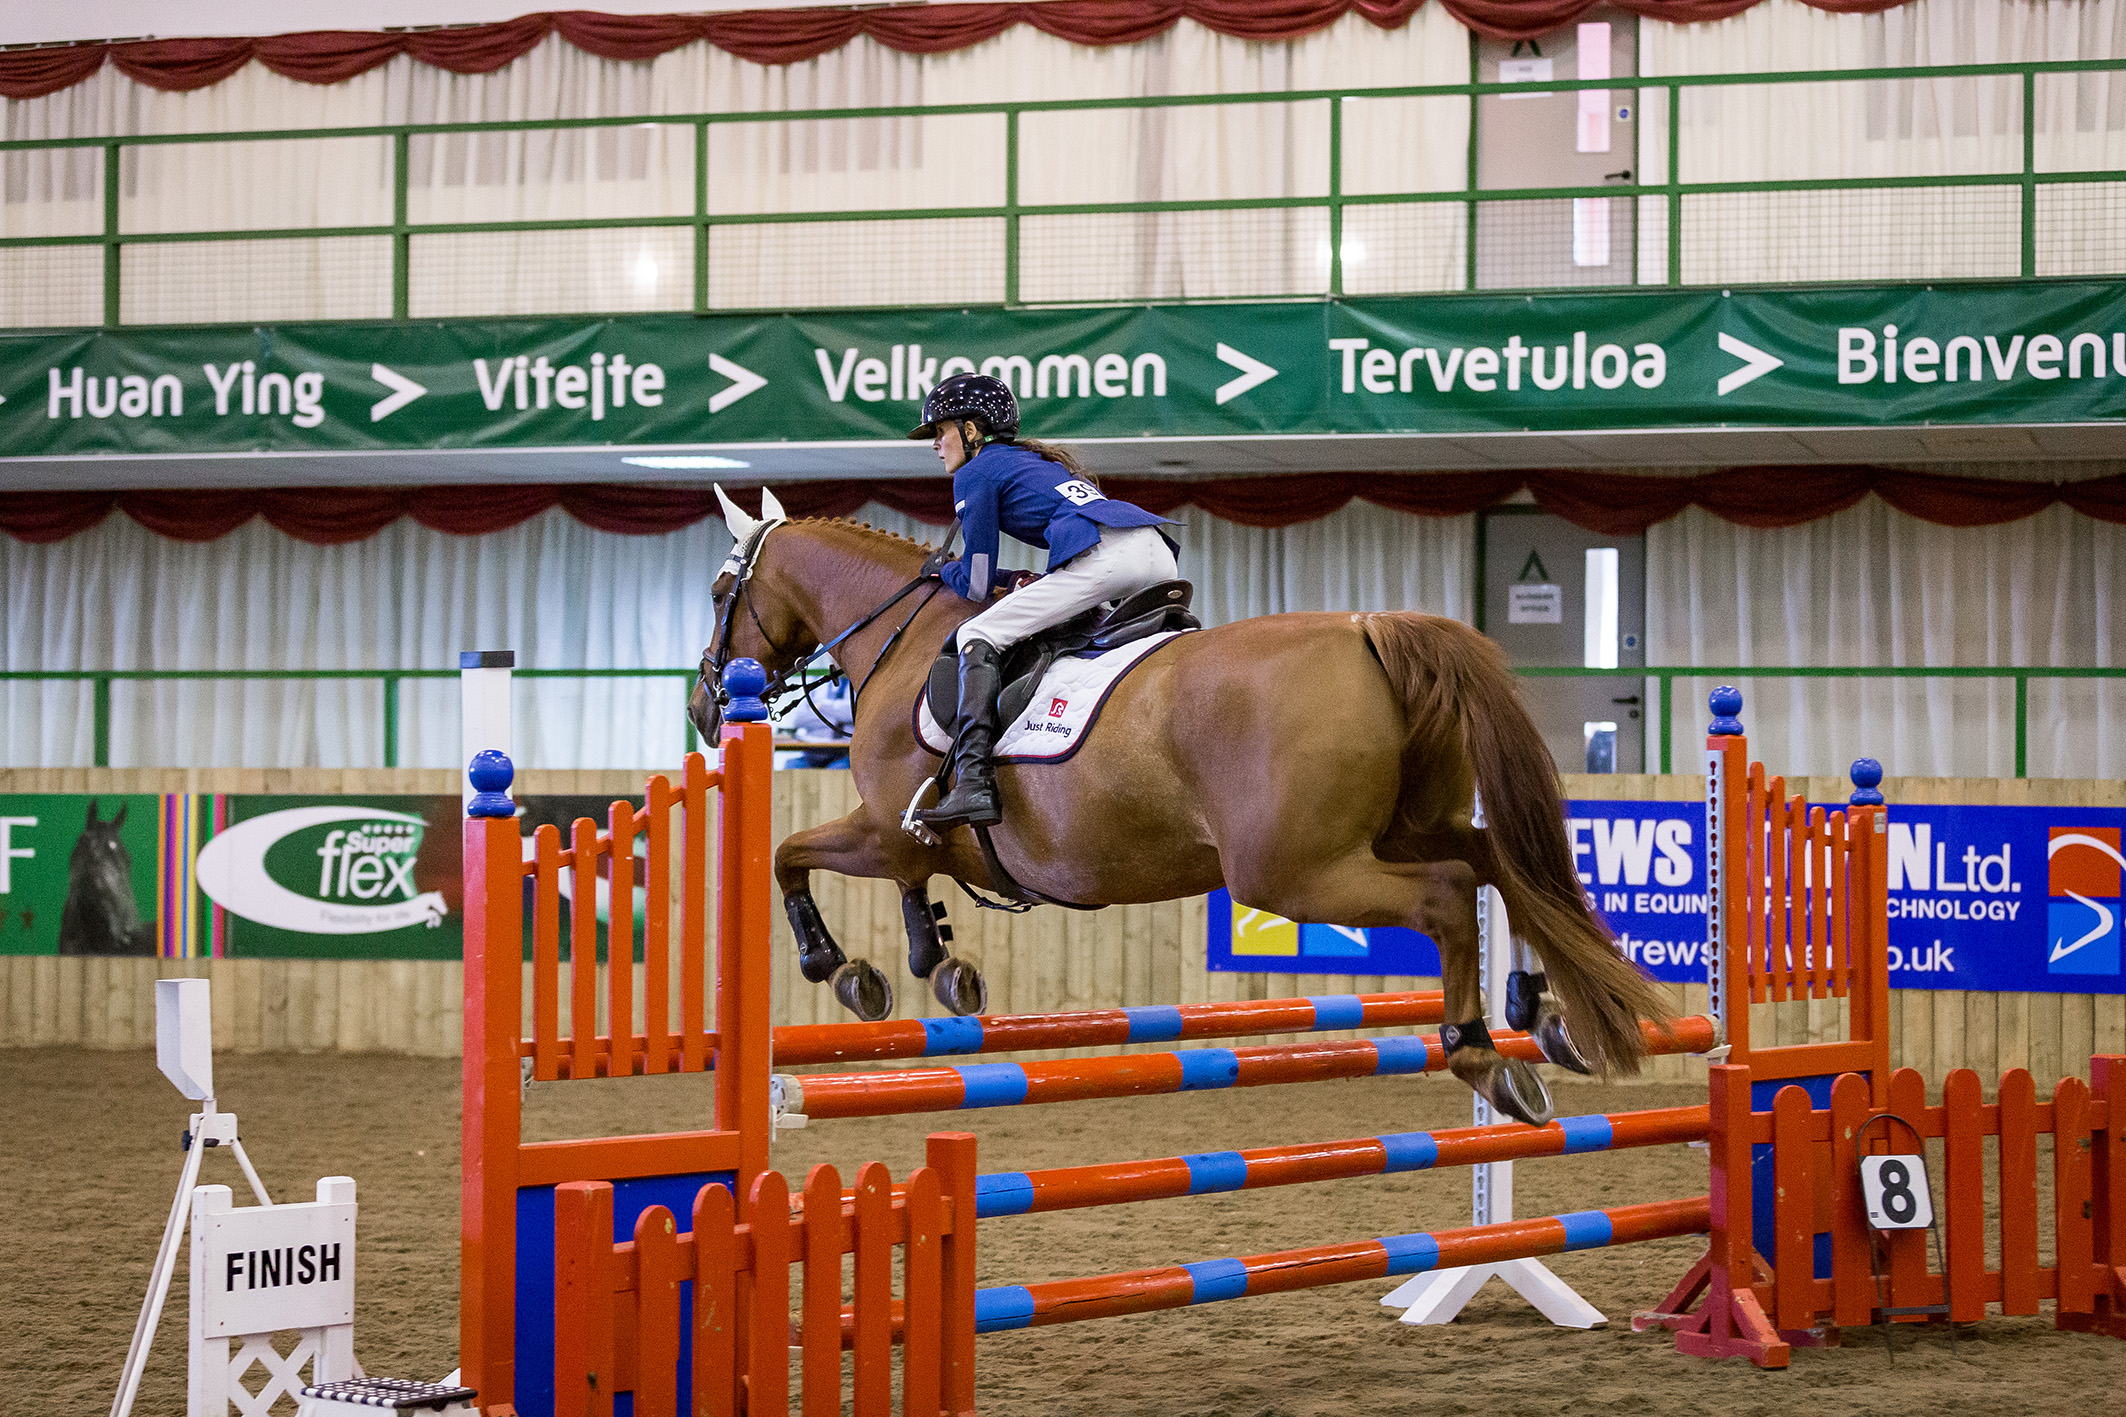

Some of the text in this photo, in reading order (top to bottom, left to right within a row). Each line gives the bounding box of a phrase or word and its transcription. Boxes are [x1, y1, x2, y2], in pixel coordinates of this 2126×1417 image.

[473, 353, 665, 421] Vitejte
[1329, 331, 1667, 394] Tervetuloa
[48, 361, 325, 428] Huan Ying
[1024, 720, 1072, 738] Just Riding
[317, 829, 418, 899] flex
[346, 831, 415, 857] Super
[1936, 842, 2021, 893] Ltd.
[1604, 892, 1627, 913] IN
[1879, 1159, 1916, 1224] 8
[225, 1242, 341, 1292] FINISH
